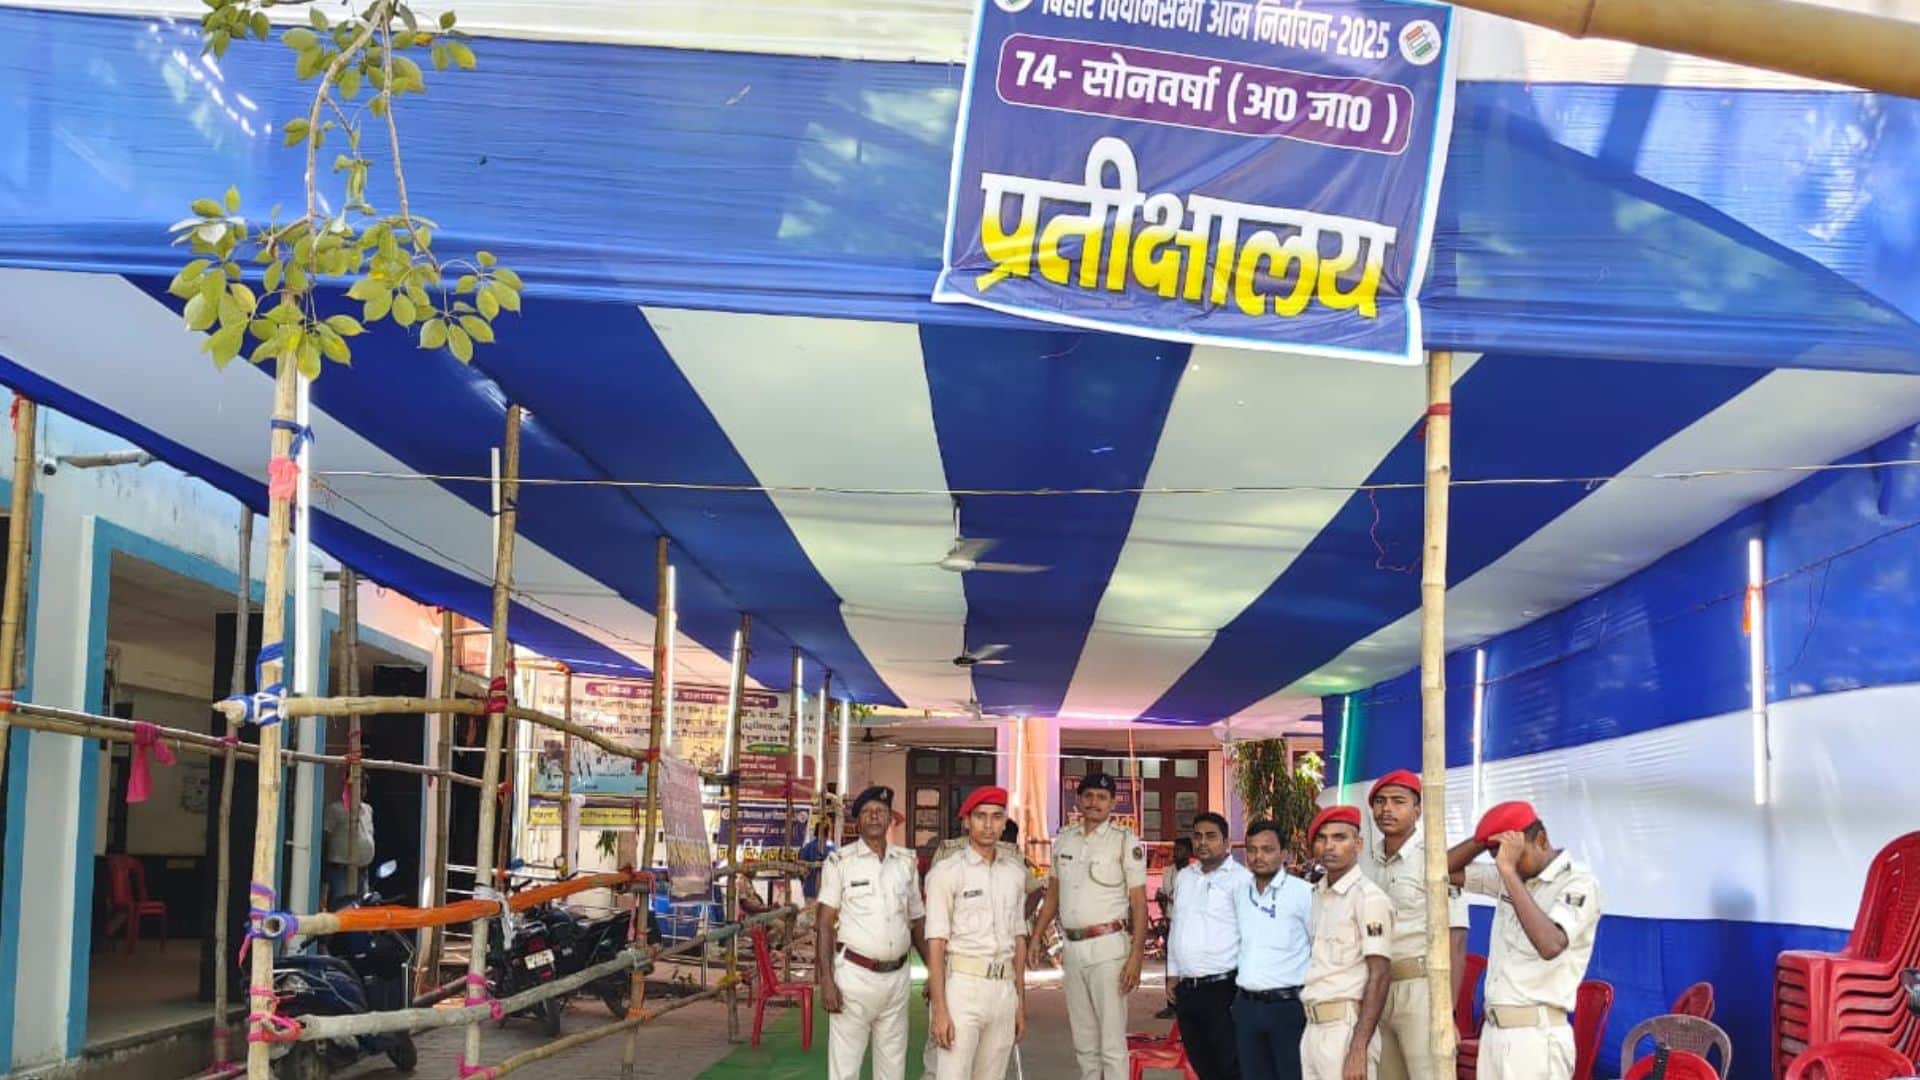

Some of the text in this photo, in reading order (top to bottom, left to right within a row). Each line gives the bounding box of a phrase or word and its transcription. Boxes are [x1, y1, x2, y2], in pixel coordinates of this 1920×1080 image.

[1206, 0, 1251, 40] आम
[1015, 50, 1073, 90] 74-
[1081, 52, 1222, 112] सोनवर्षा
[979, 136, 1397, 319] प्रतीक्षालय
